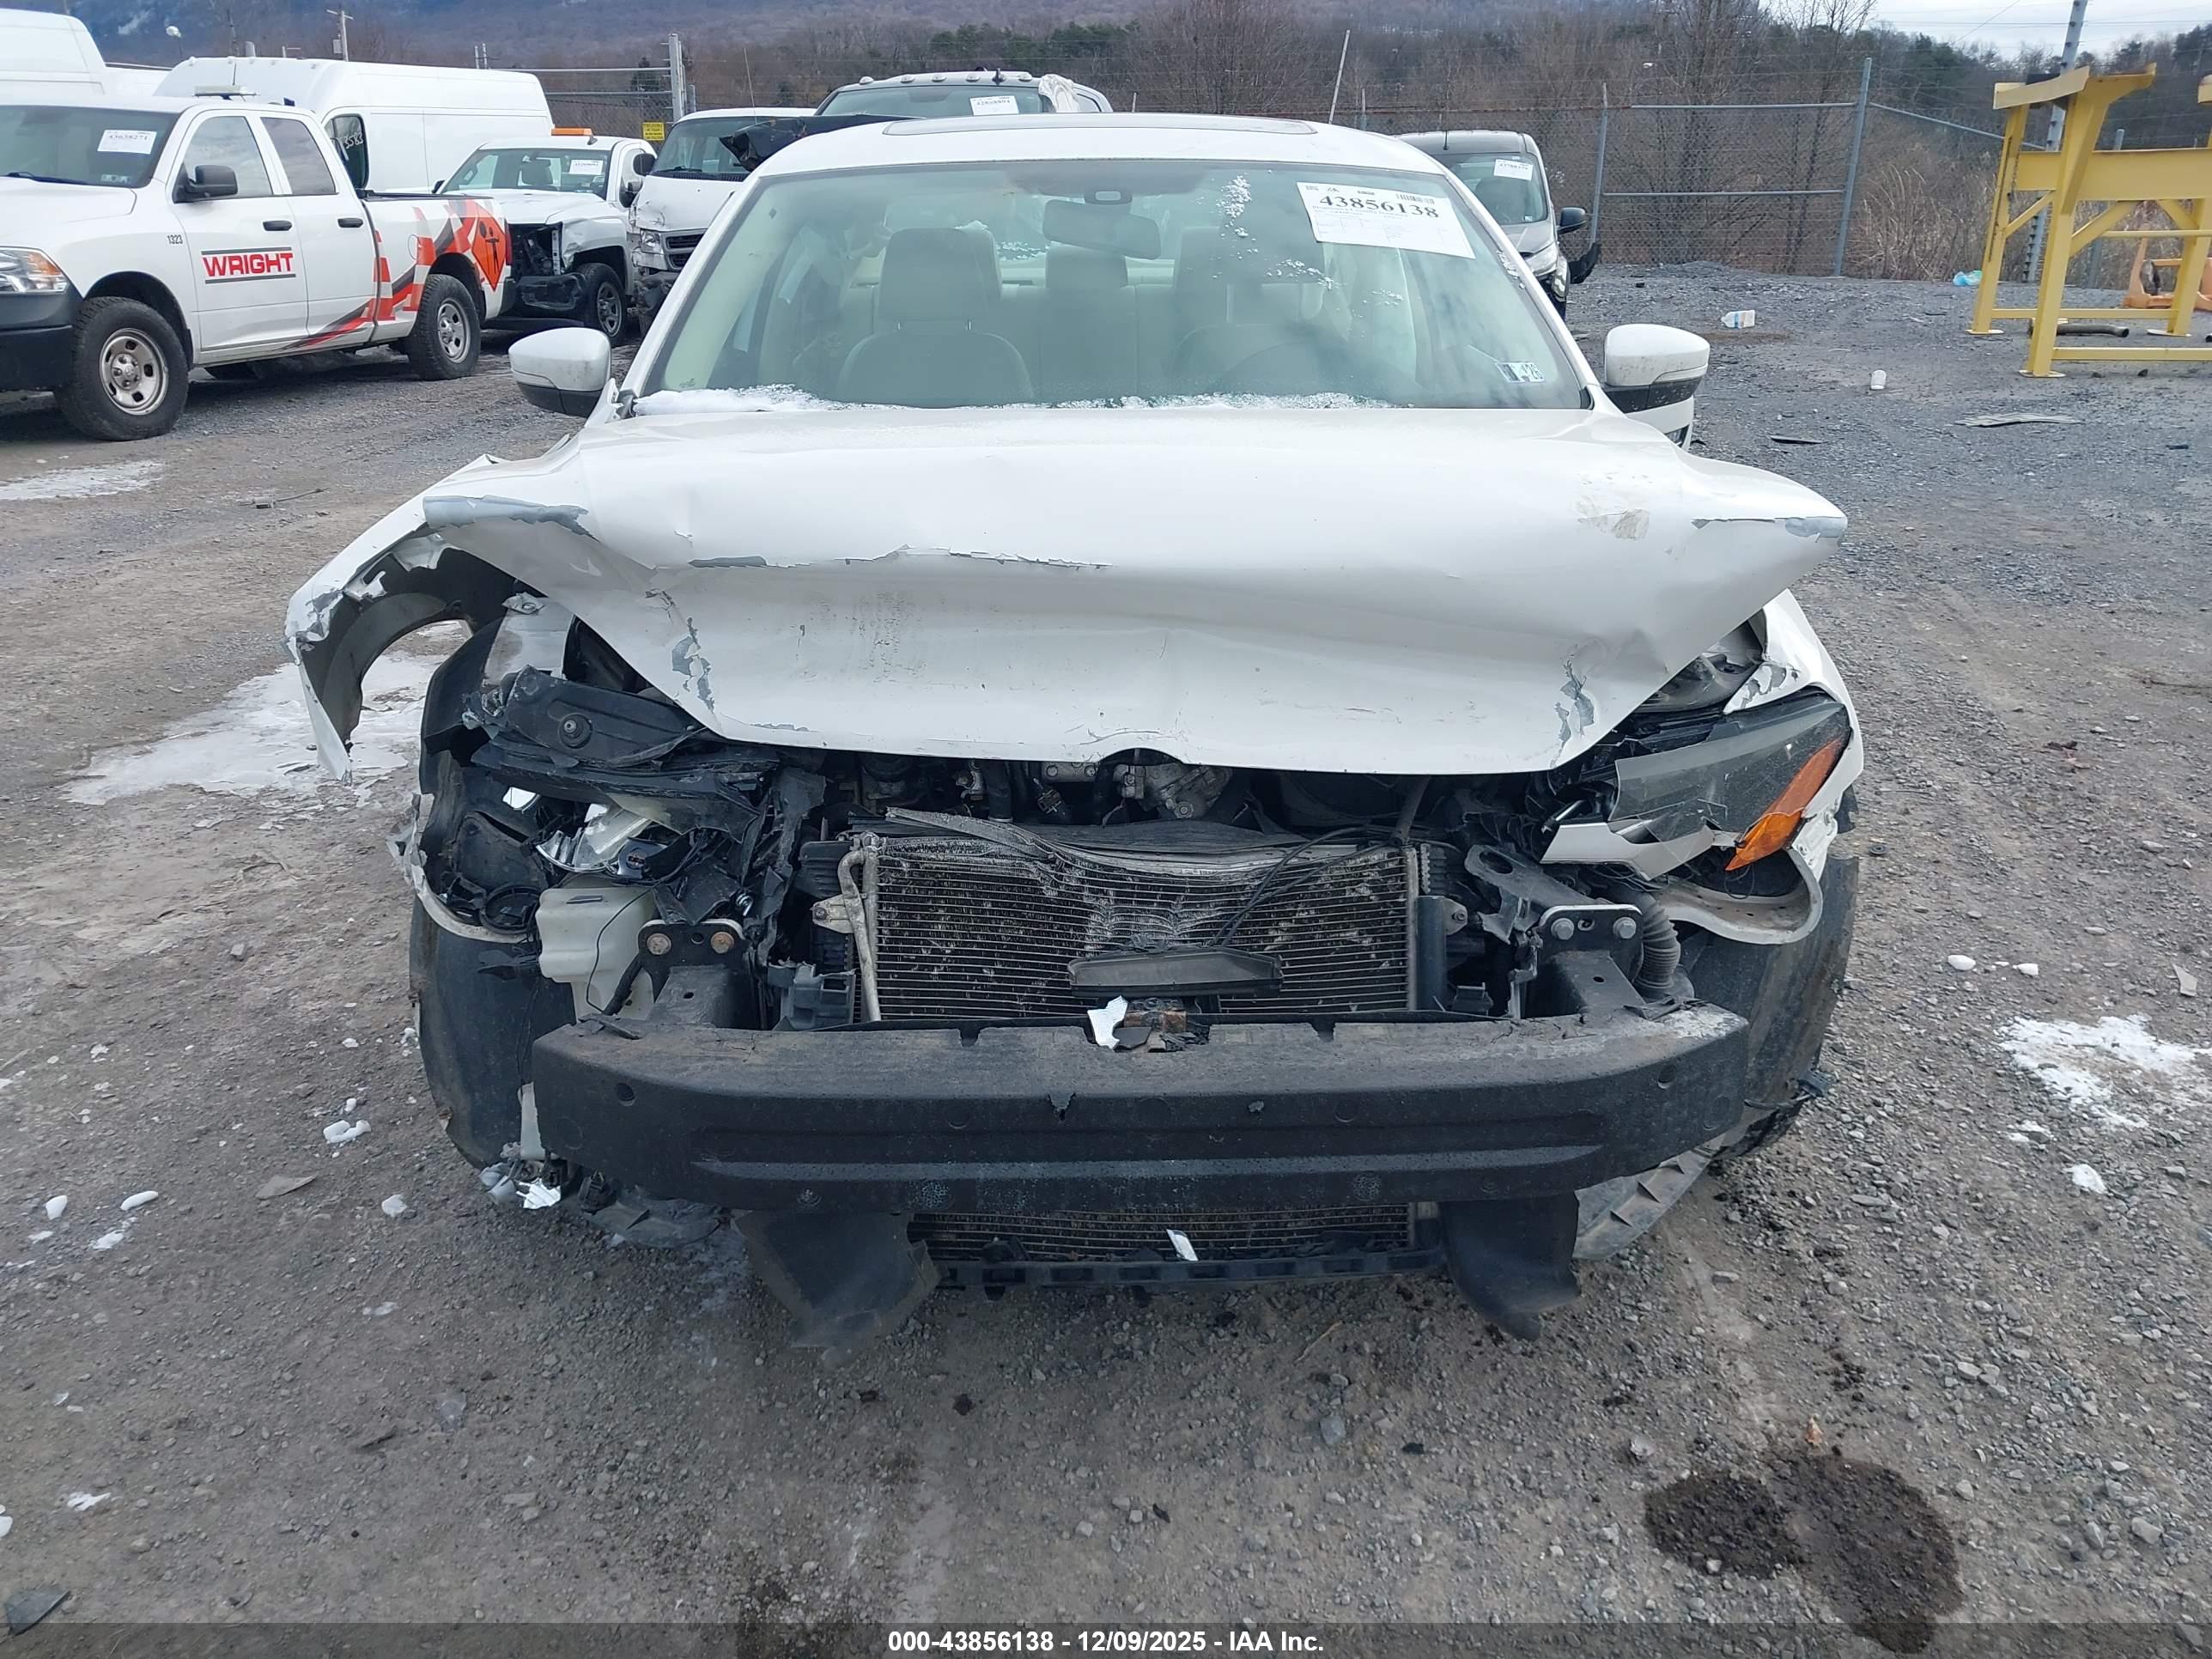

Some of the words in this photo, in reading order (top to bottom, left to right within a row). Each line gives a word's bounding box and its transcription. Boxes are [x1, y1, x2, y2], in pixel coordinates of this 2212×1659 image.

[1320, 195, 1439, 218] 43856138
[167, 234, 184, 245] 1323
[203, 252, 294, 277] WRIGHT
